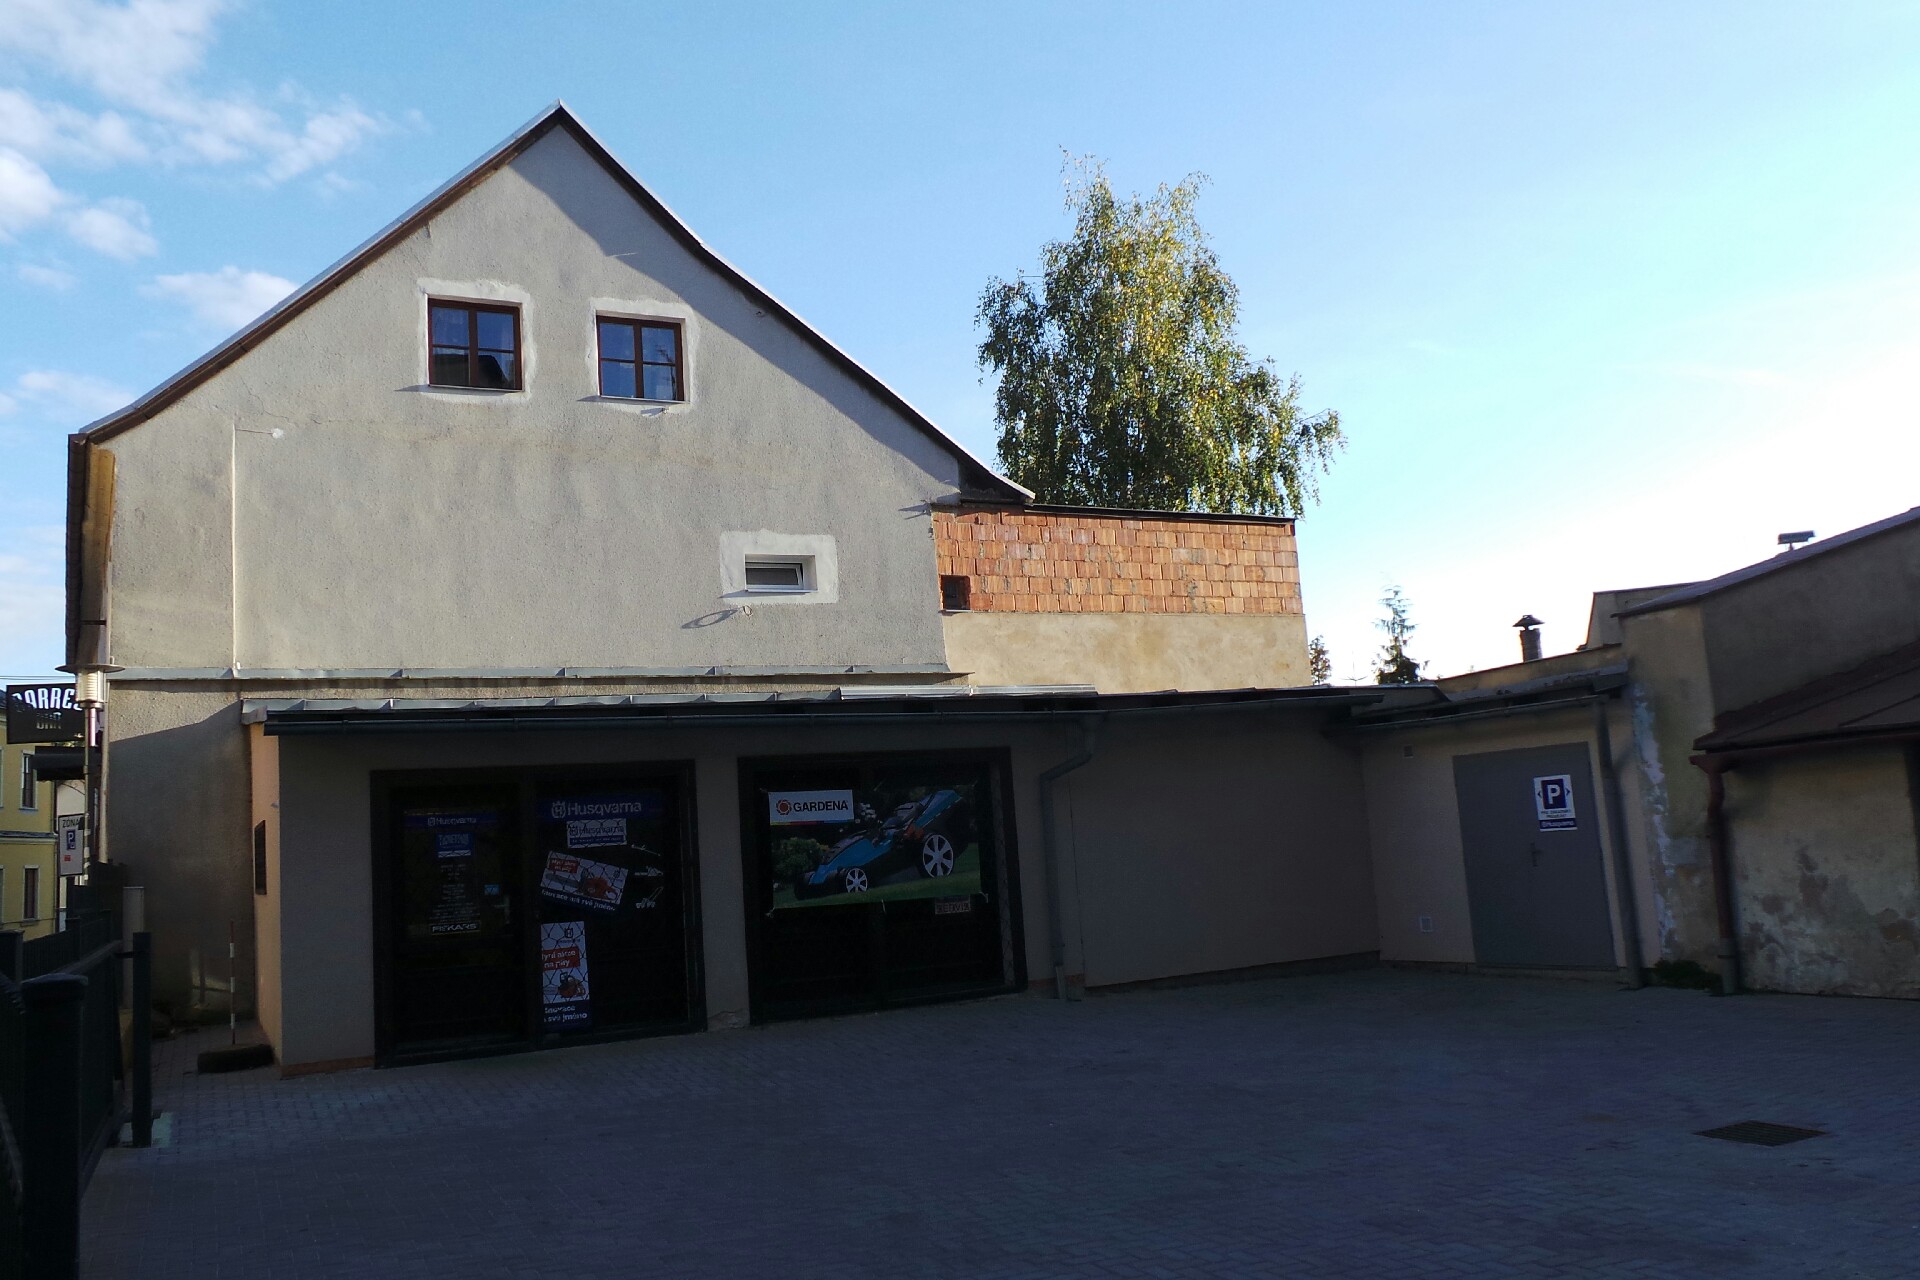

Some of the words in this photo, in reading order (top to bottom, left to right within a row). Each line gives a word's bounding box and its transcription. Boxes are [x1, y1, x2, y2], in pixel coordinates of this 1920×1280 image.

[1547, 784, 1560, 804] P
[568, 802, 642, 816] Husqvarna
[793, 800, 849, 812] GARDENA
